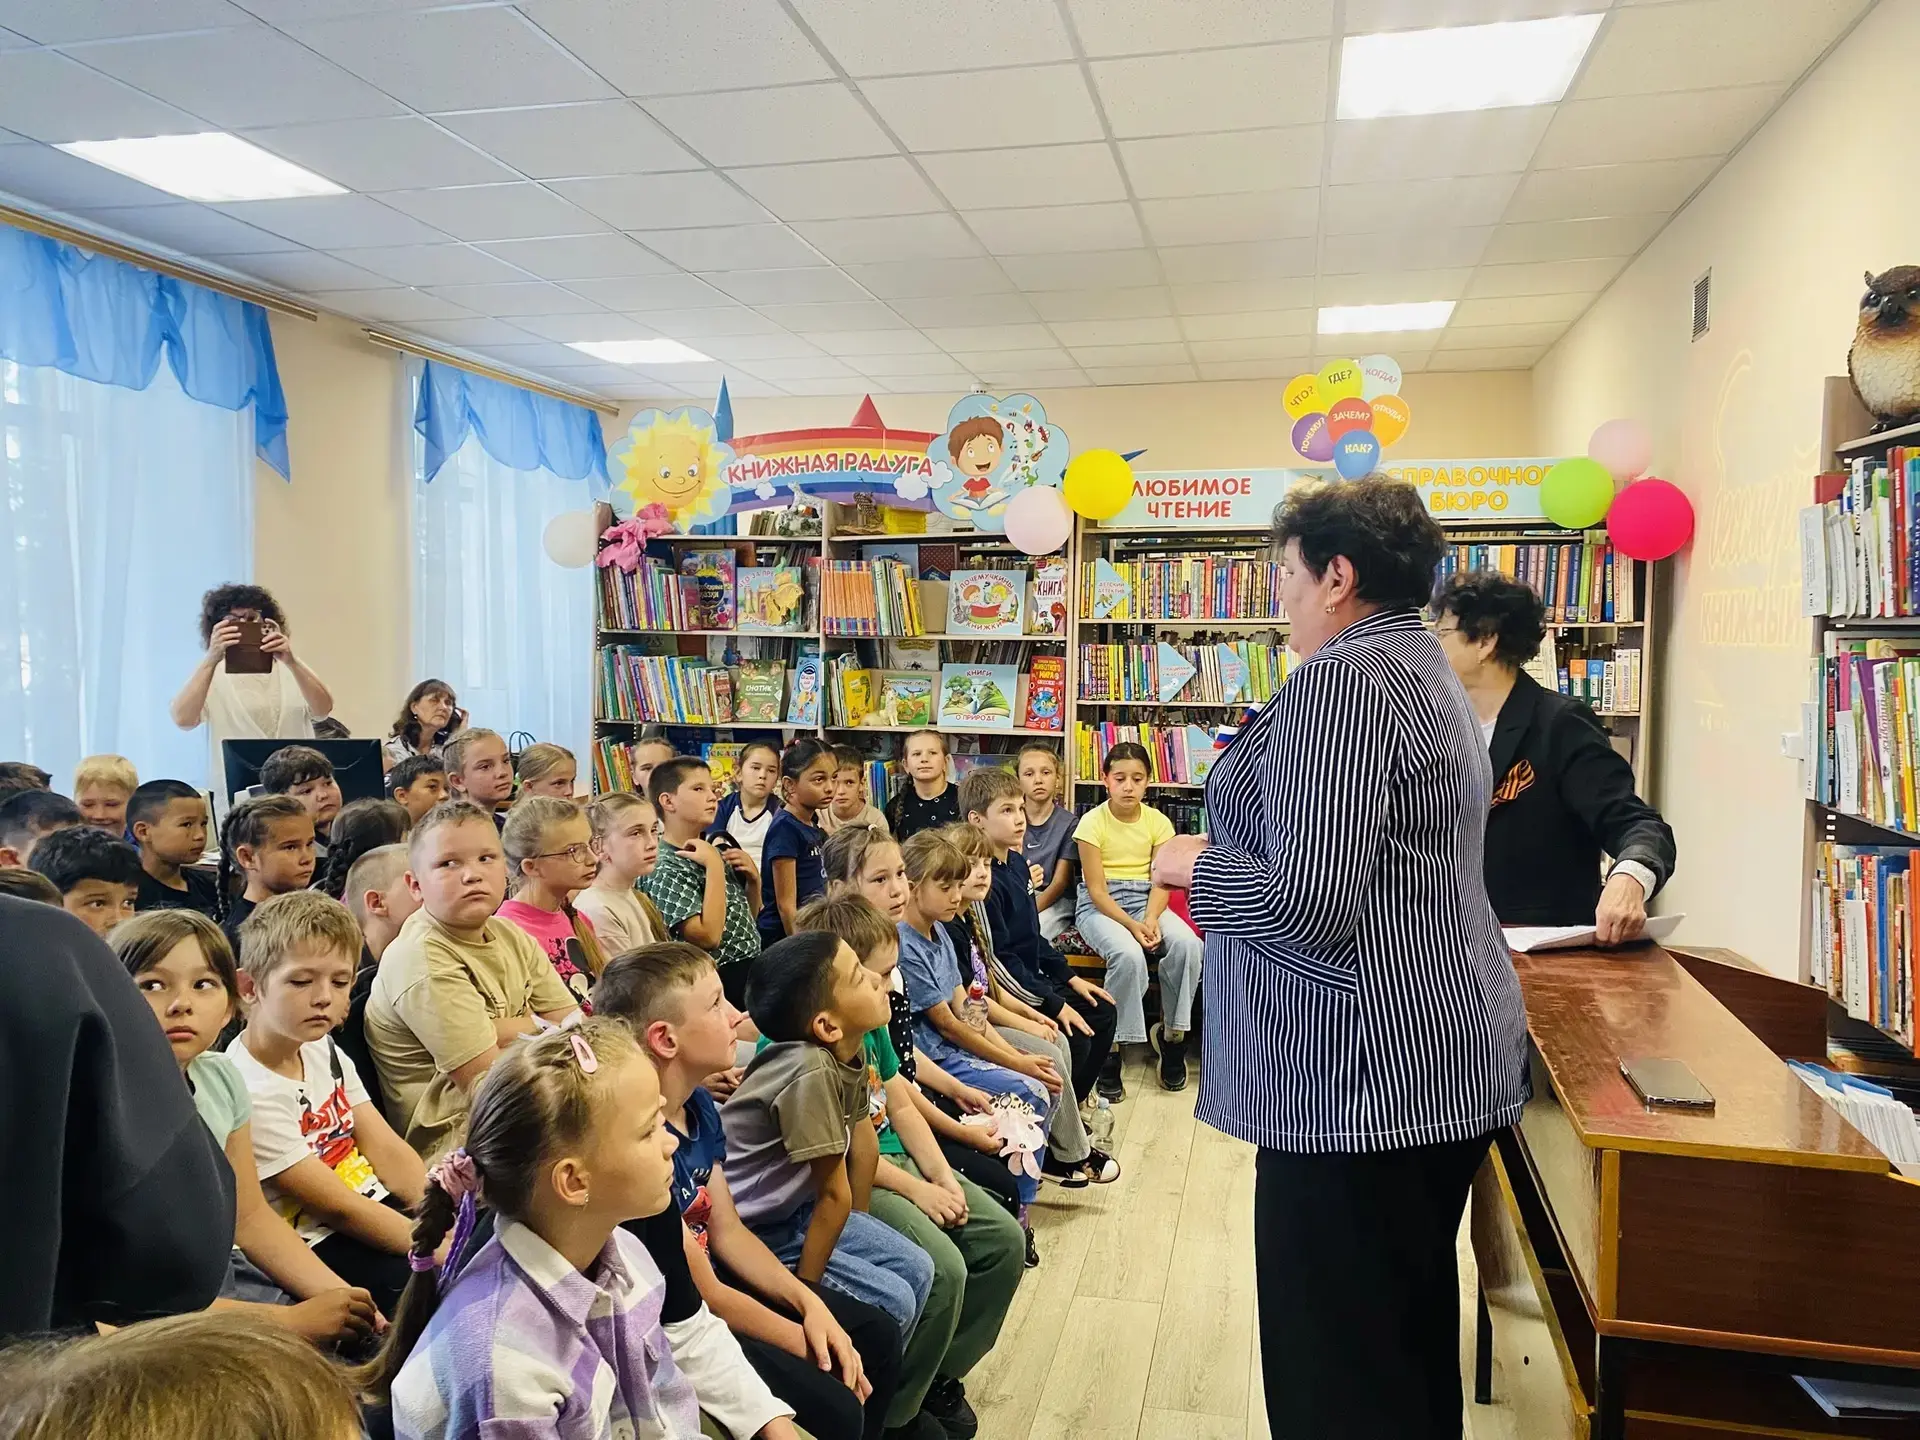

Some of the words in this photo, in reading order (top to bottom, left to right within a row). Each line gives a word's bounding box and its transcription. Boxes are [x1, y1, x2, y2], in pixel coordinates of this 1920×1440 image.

[1328, 369, 1352, 384] ГДЕ?
[1365, 368, 1397, 384] КОГДА?
[1290, 386, 1314, 407] ЧТО?
[1333, 410, 1371, 422] ЗАЧЕМ?
[1373, 403, 1406, 423] ОТКУДА?
[1300, 417, 1325, 453] ПОЧЕМУ?
[1344, 443, 1373, 454] КАК?
[727, 452, 840, 484] КНИЖНАЯ
[843, 452, 933, 477] РАДУГА
[1386, 464, 1554, 487] СПРАВОЧНО
[1131, 477, 1251, 497] ЛЮБИМОЕ
[1429, 490, 1509, 512] БЮРО
[1147, 500, 1231, 519] ЧТЕНИЕ
[959, 573, 1015, 589] ПОЧЕМУЧКИНЫ
[1037, 580, 1062, 596] КНИГА
[965, 621, 1003, 631] КНИЖКИ
[966, 669, 992, 677] КНИГИ
[962, 714, 996, 722] ПРИРОДЕ
